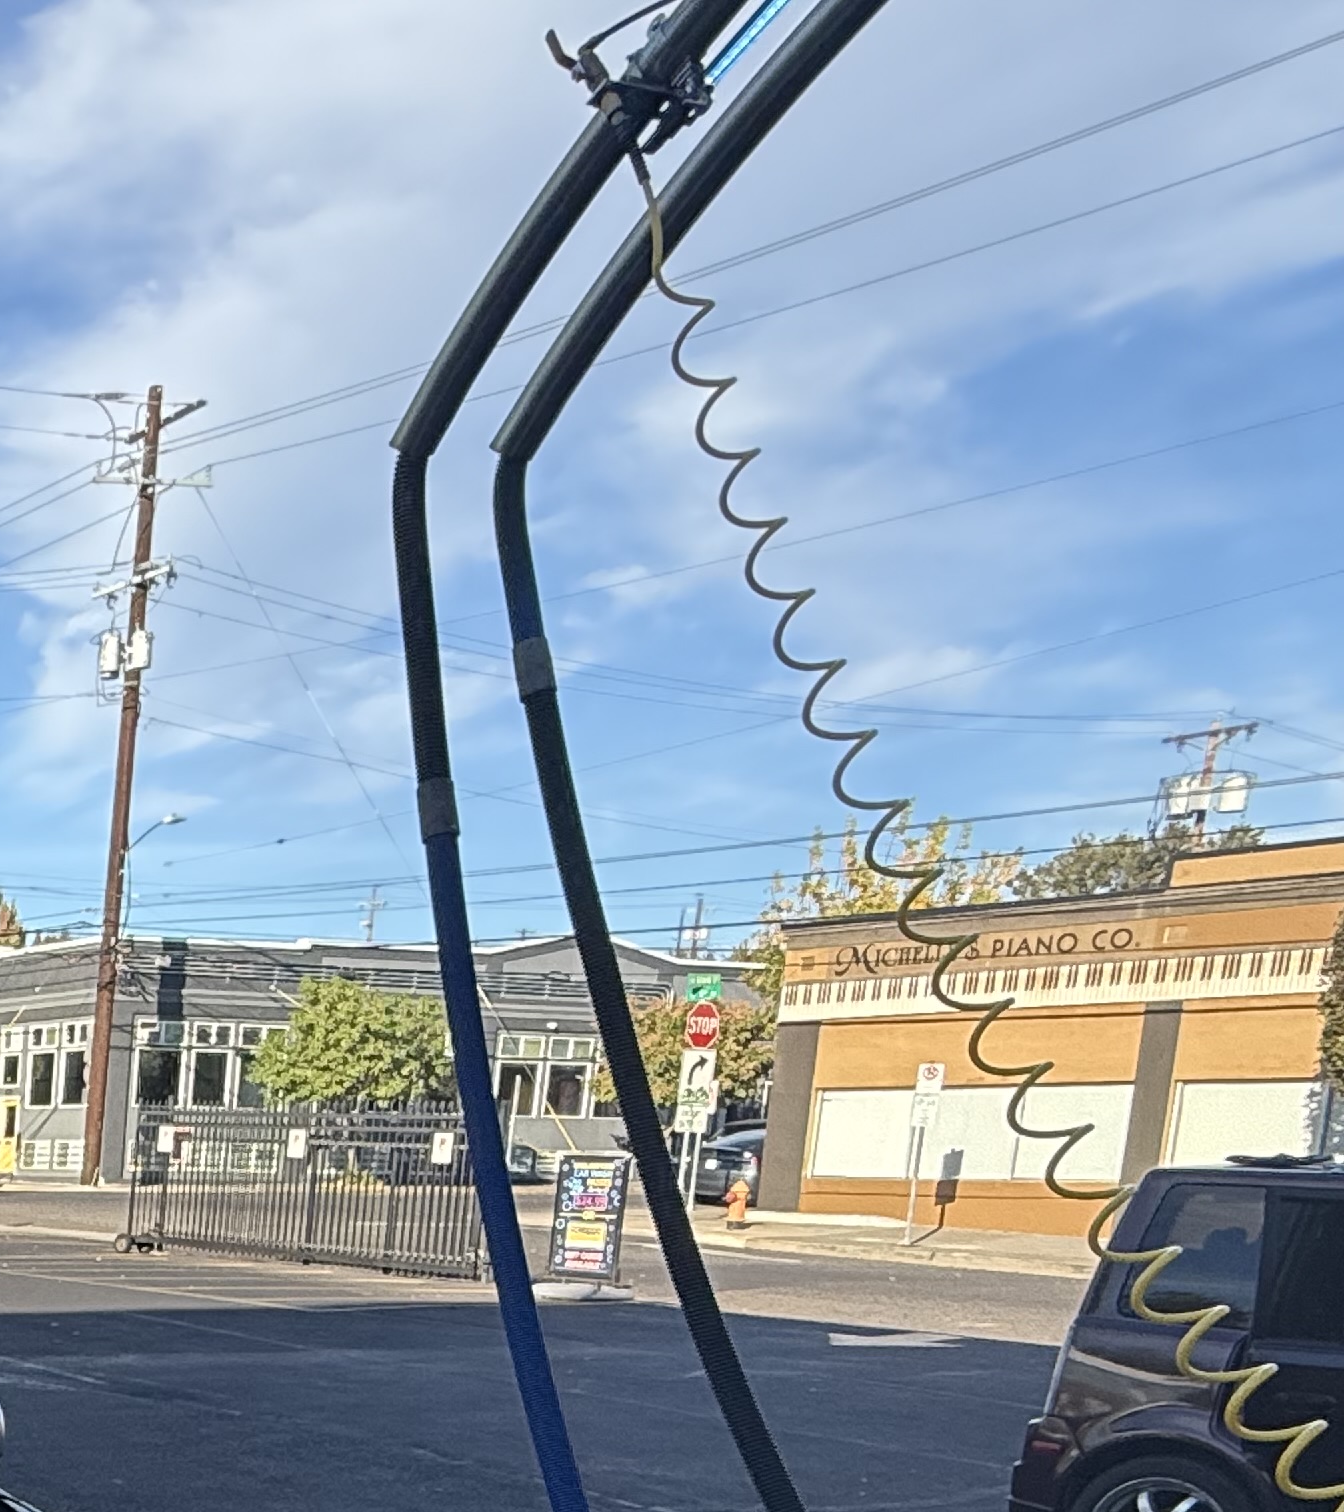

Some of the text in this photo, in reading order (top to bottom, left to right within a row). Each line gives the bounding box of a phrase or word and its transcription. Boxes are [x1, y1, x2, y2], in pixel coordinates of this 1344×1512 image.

[991, 932, 1078, 959] PIANO
[1092, 928, 1141, 951] CO.
[688, 1016, 718, 1036] STOP
